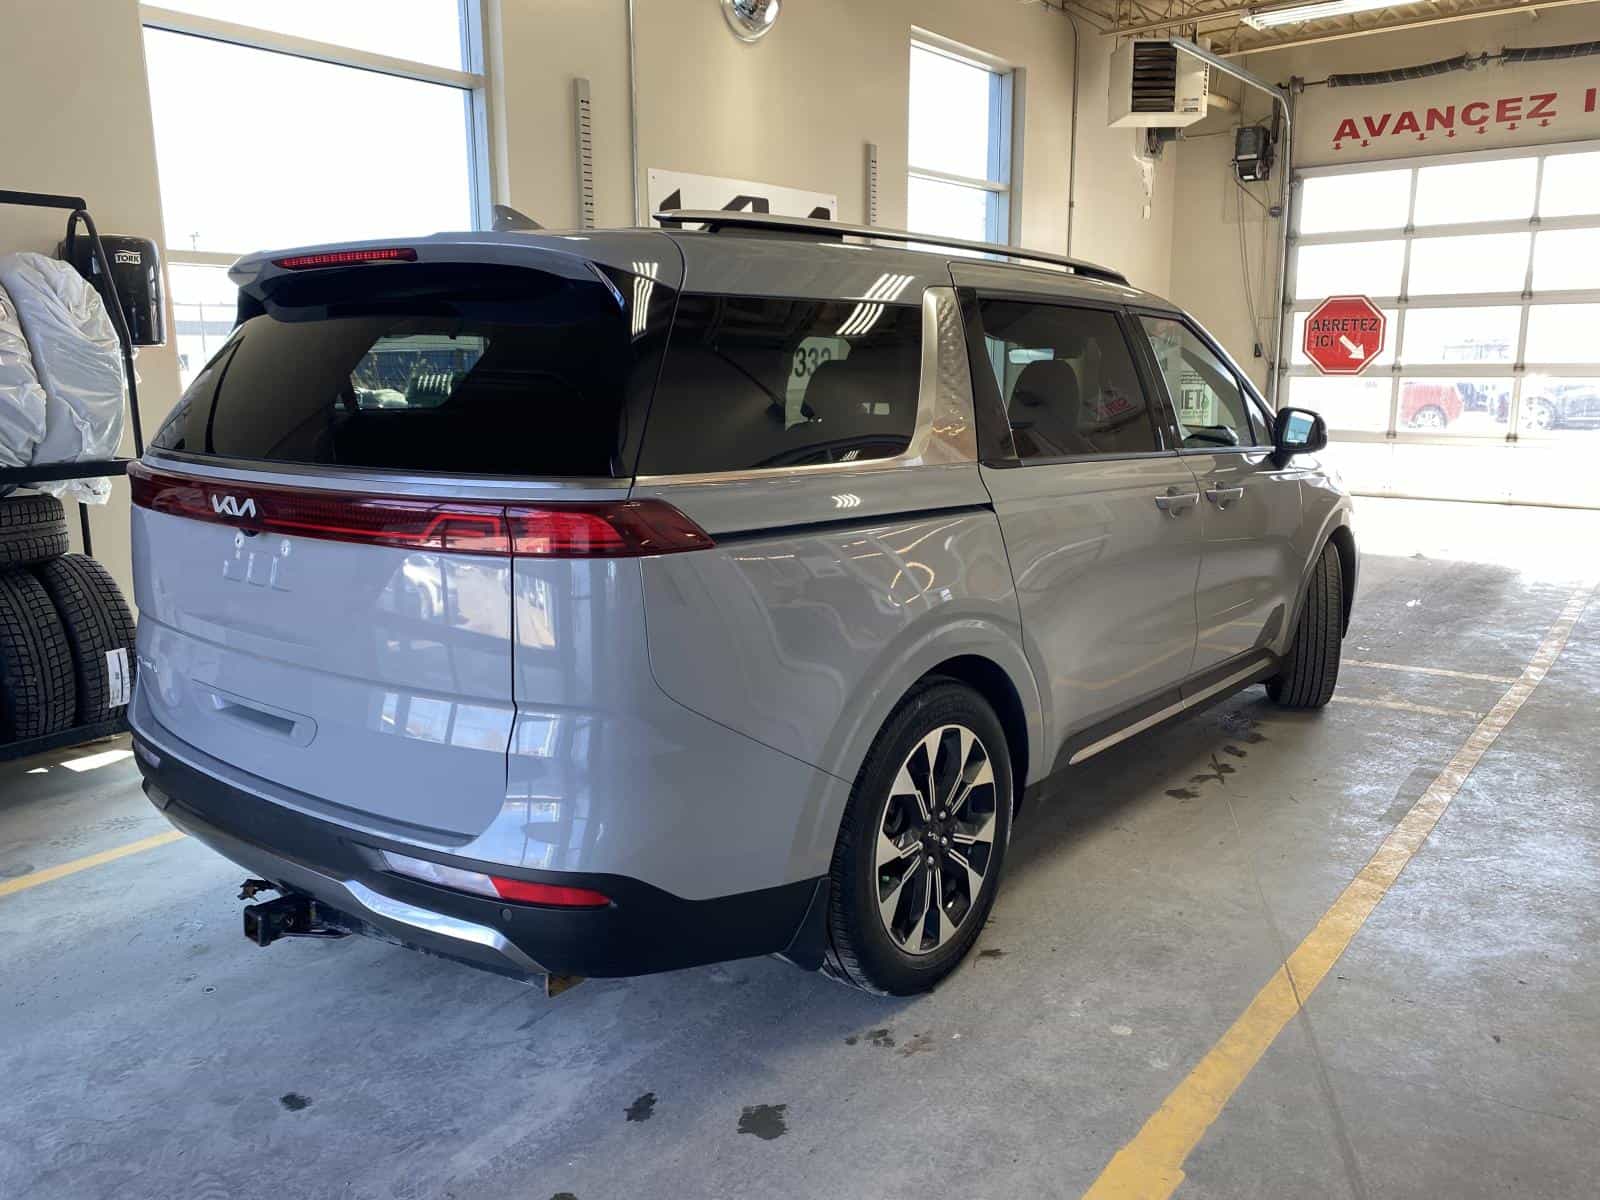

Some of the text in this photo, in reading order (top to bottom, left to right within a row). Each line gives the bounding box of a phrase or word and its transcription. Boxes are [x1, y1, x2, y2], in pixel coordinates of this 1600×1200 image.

[1332, 92, 1558, 142] AVANCEZ
[115, 253, 141, 264] TORK
[1312, 318, 1378, 332] ARRETEZ
[1315, 335, 1334, 347] ICI
[211, 494, 257, 518] KIA
